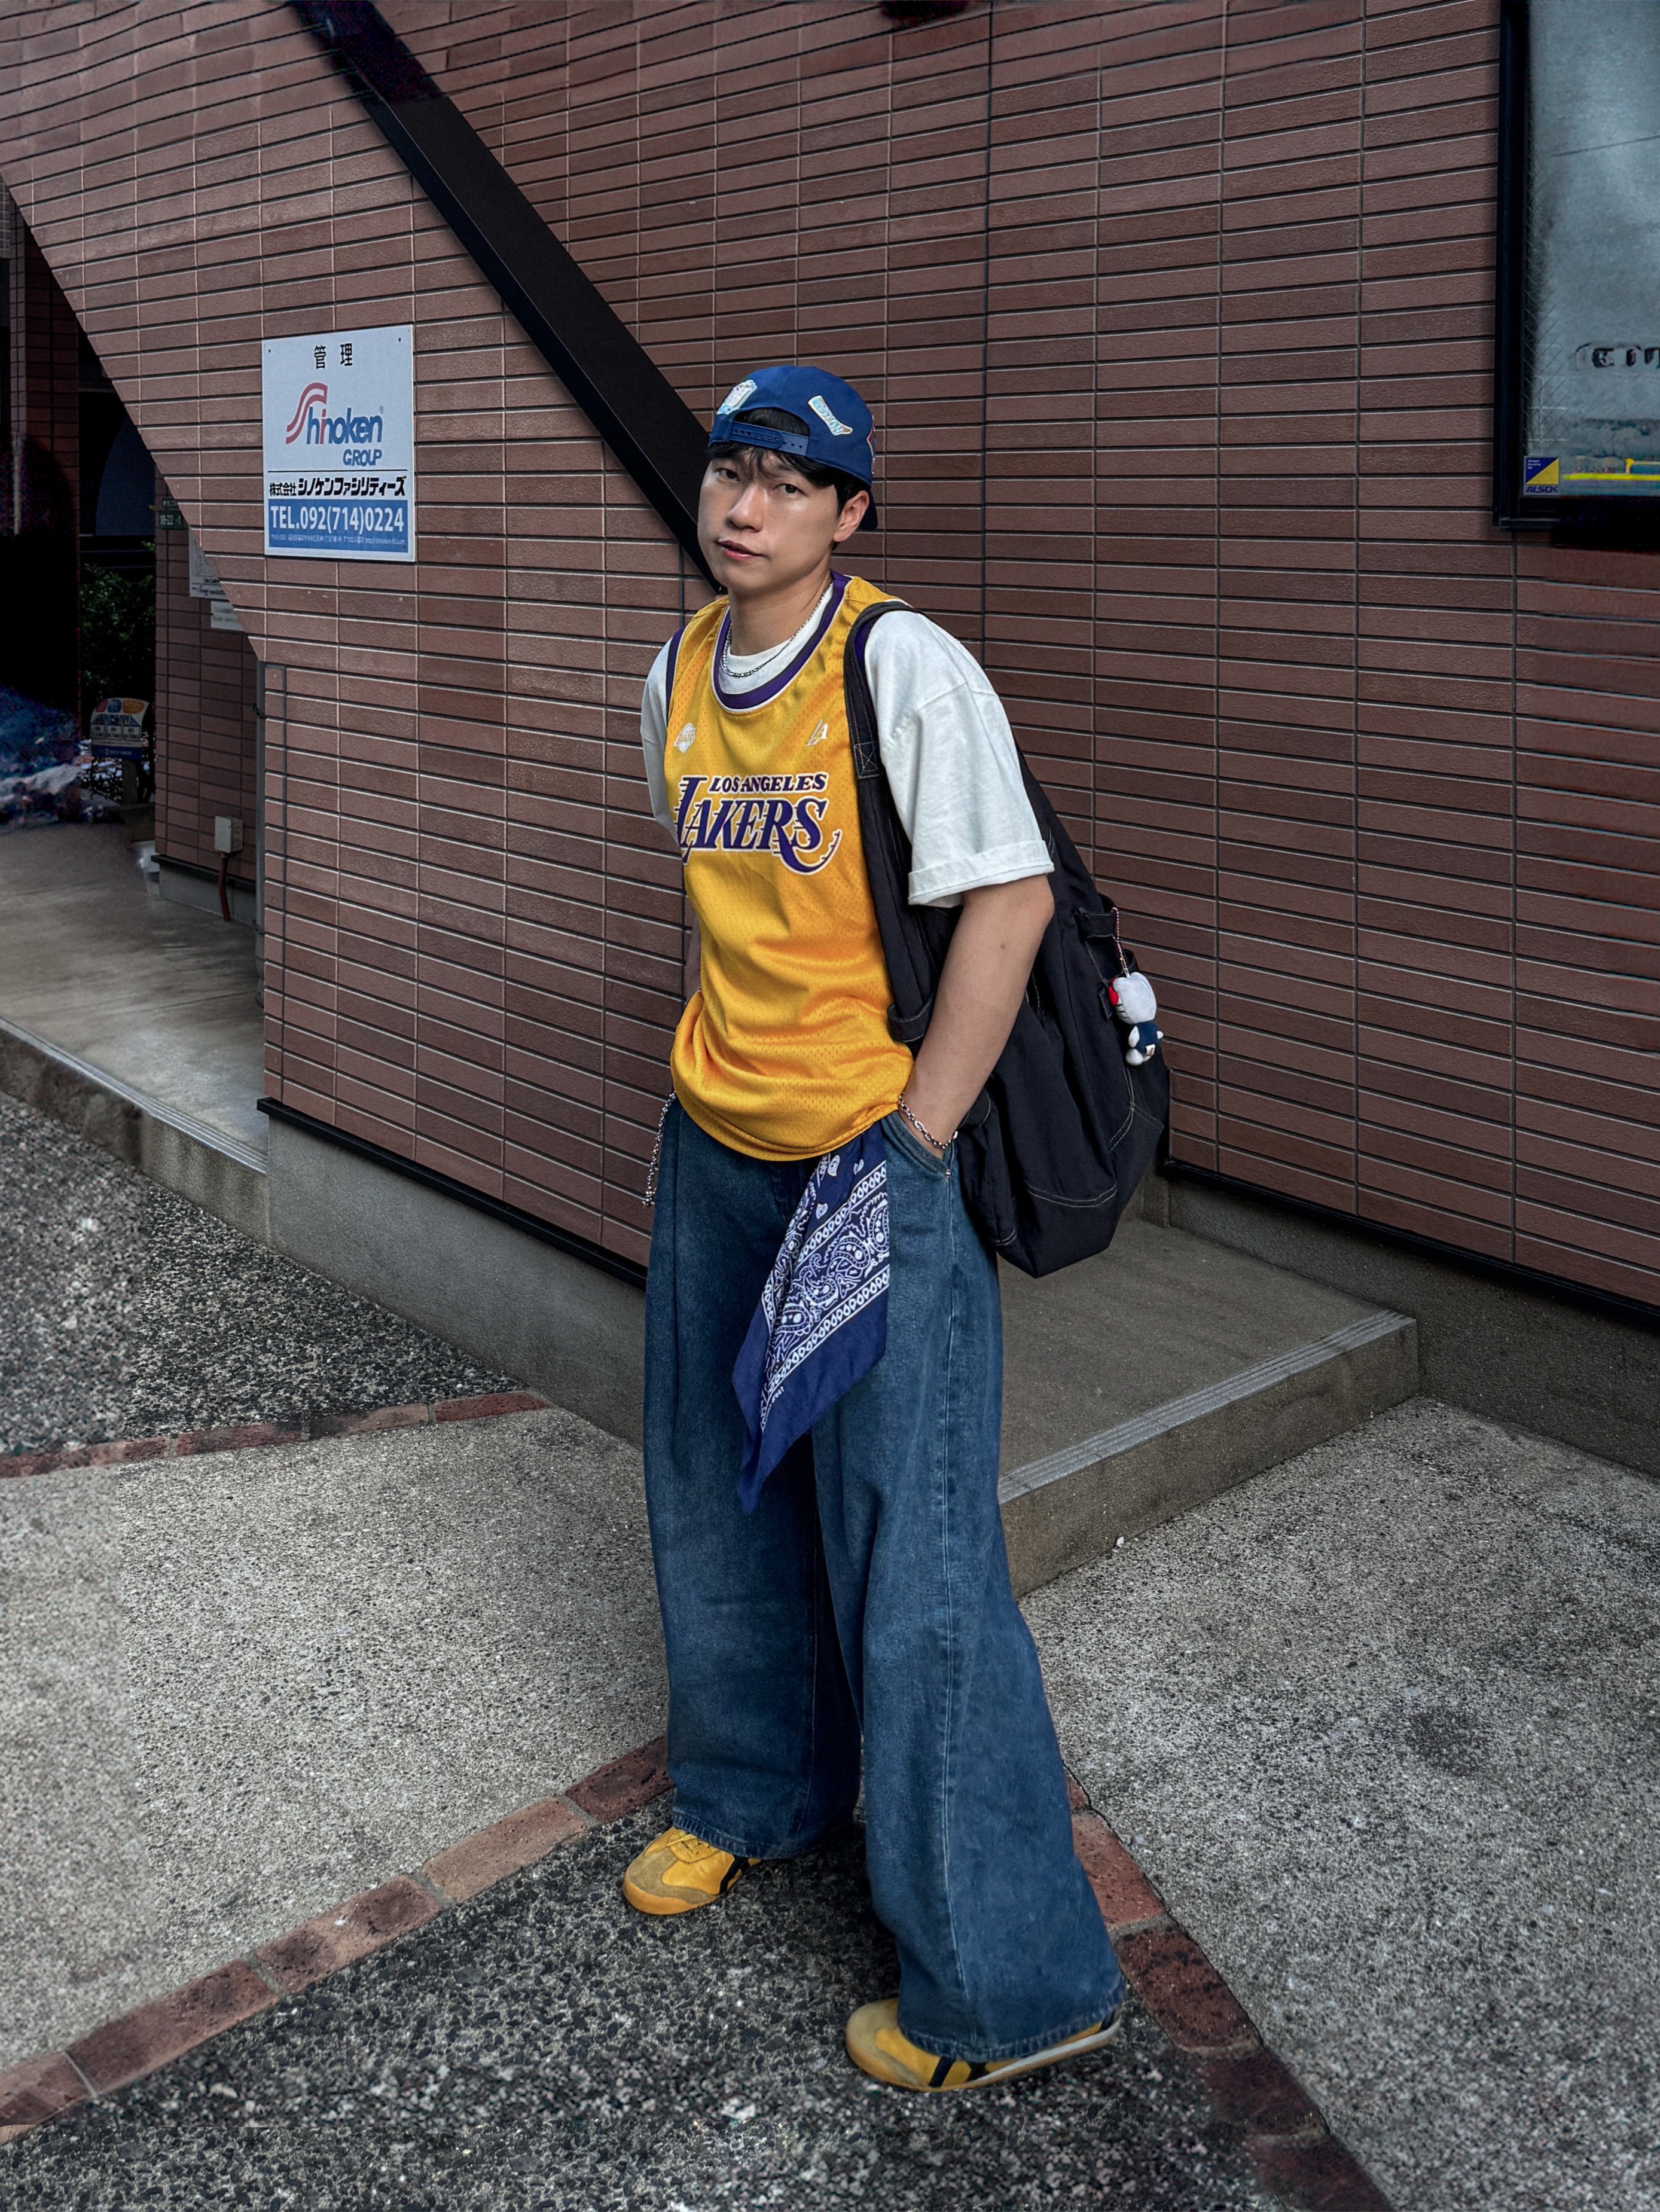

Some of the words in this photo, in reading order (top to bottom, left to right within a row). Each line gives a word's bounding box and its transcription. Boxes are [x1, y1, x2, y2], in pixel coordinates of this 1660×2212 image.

[314, 343, 353, 370] 管理
[286, 382, 383, 444] Shinoken
[343, 448, 383, 466] GROUP
[708, 776, 740, 794] LOS
[739, 771, 829, 794] ANGELES
[674, 775, 843, 875] LAKERS
